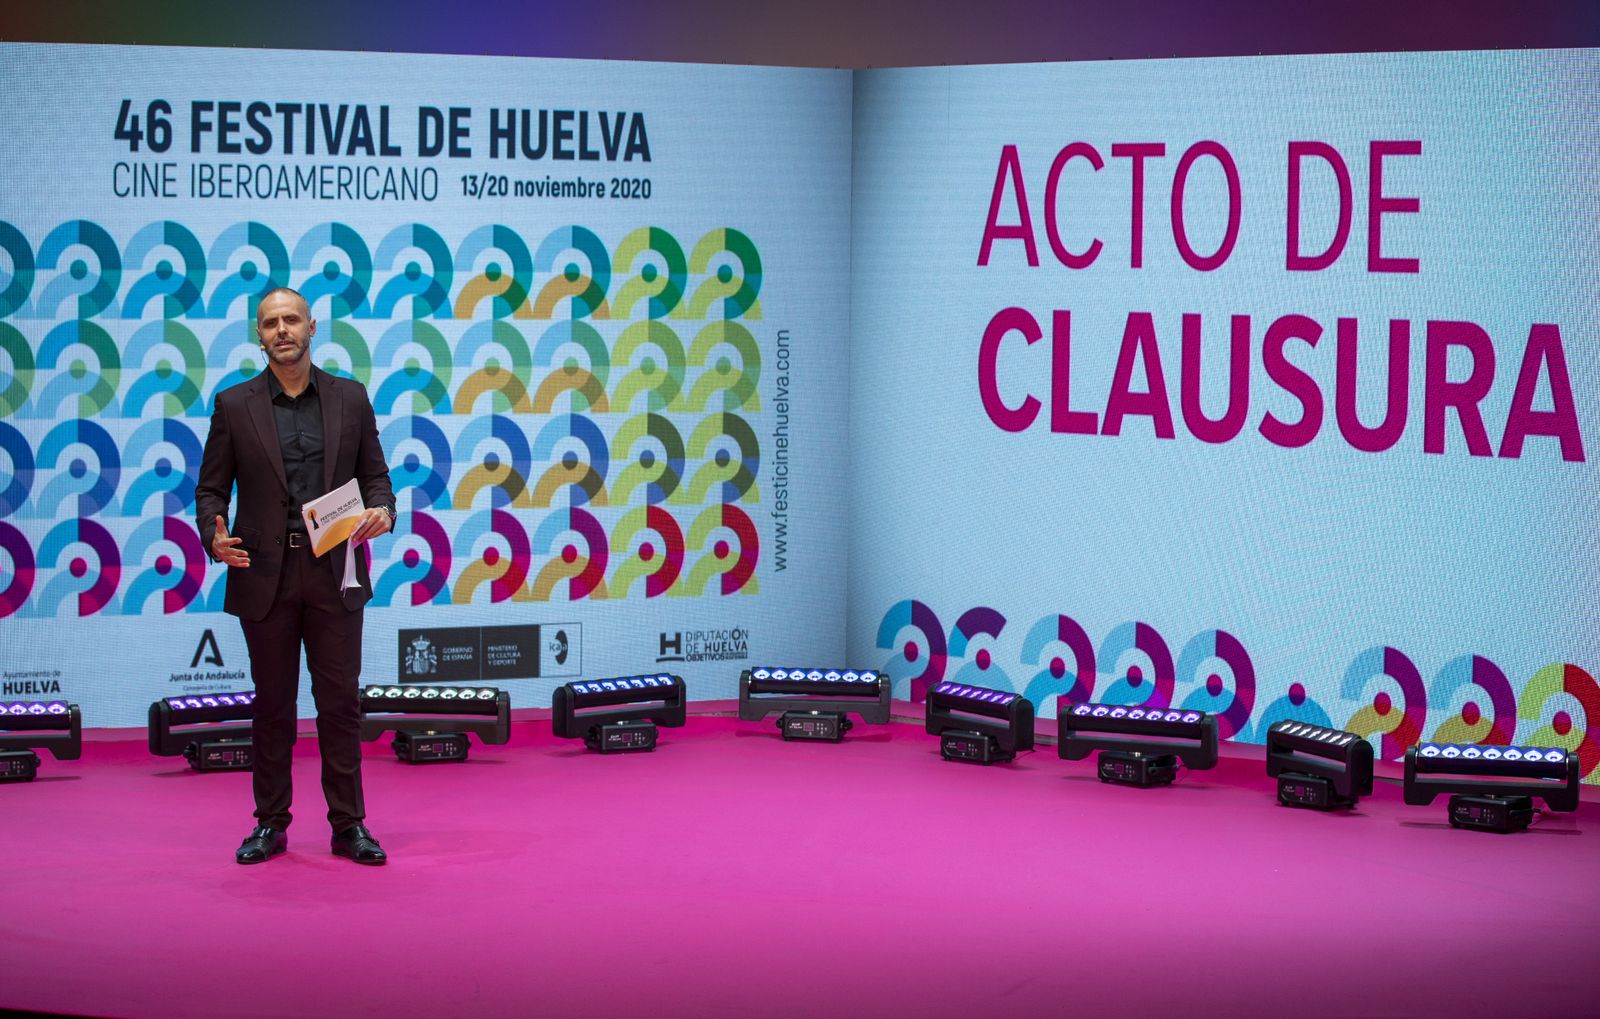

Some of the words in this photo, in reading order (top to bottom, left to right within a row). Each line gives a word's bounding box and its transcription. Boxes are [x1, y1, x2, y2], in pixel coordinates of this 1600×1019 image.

[114, 98, 173, 154] 46
[190, 100, 401, 157] FESTIVAL
[418, 106, 472, 159] DE
[490, 108, 652, 163] HUELVA
[112, 162, 177, 198] CINE
[190, 163, 439, 202] IBEROAMERICANO
[460, 174, 509, 199] 13/20
[514, 175, 605, 199] noviembre
[610, 176, 652, 200] 2020
[976, 140, 1242, 272] ACTO
[1286, 140, 1422, 274] DE
[977, 306, 1586, 463] CLAUSURA
[771, 329, 790, 573] www.festicinehuelva.com
[686, 626, 749, 642] DIPUTACIÓN
[442, 646, 473, 654] GOBIERNO
[496, 651, 521, 659] CULTURA
[686, 643, 700, 654] DE
[704, 641, 748, 653] HUELVA
[451, 653, 473, 661] ESPAÑA
[686, 652, 725, 662] OBJETIVOS
[169, 672, 192, 682] Junta
[194, 672, 204, 681] de
[206, 669, 245, 681] Andalucía
[3, 680, 61, 696] HUELVA
